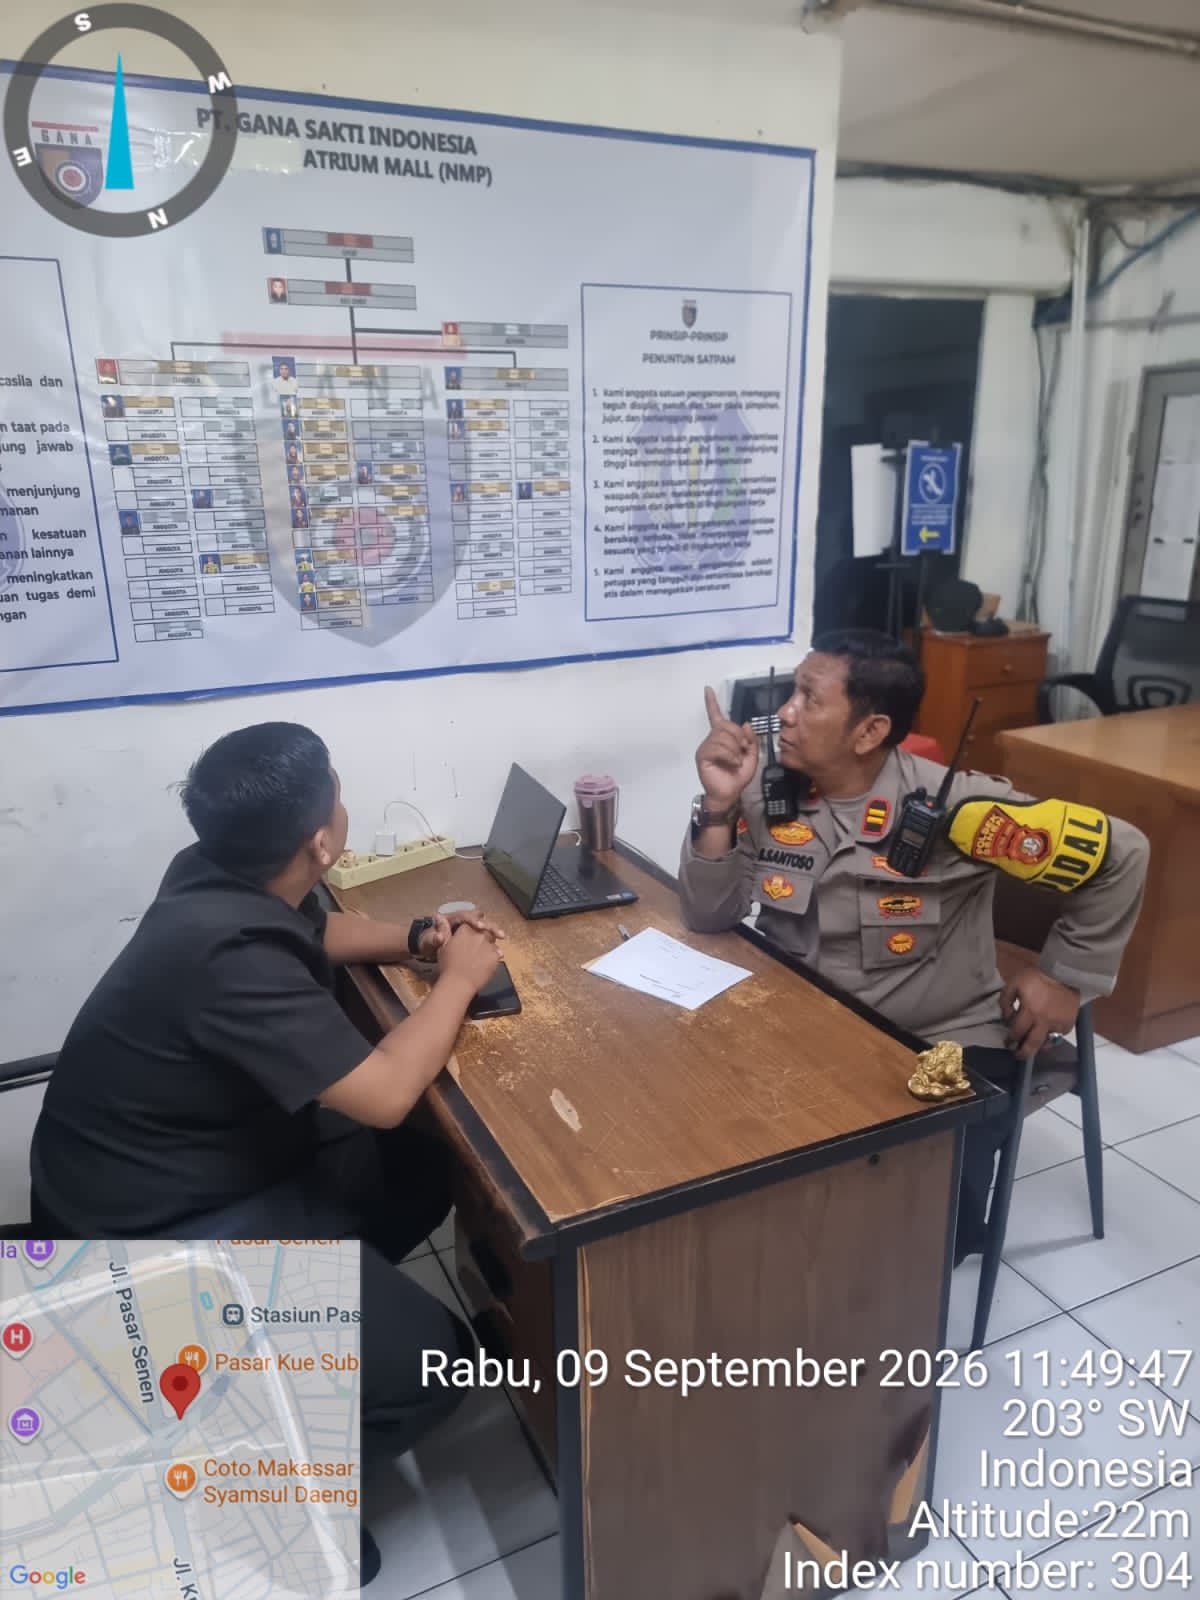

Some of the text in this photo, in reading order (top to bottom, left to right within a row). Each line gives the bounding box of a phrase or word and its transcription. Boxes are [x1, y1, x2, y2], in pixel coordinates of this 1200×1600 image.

[196, 107, 477, 155] PT. GANA SAKTI INDONESIA
[303, 149, 493, 187] ATRIUM MALL (NMP)
[40, 376, 63, 387] dan
[11, 421, 37, 433] taat
[40, 421, 70, 435] pada
[36, 440, 74, 455] jawab
[6, 484, 81, 500] menjunjung
[31, 529, 88, 541] kesatuan
[31, 546, 74, 560] lainnya
[6, 570, 94, 585] meningkatkan
[26, 590, 60, 603] tugas
[66, 586, 96, 600] demi
